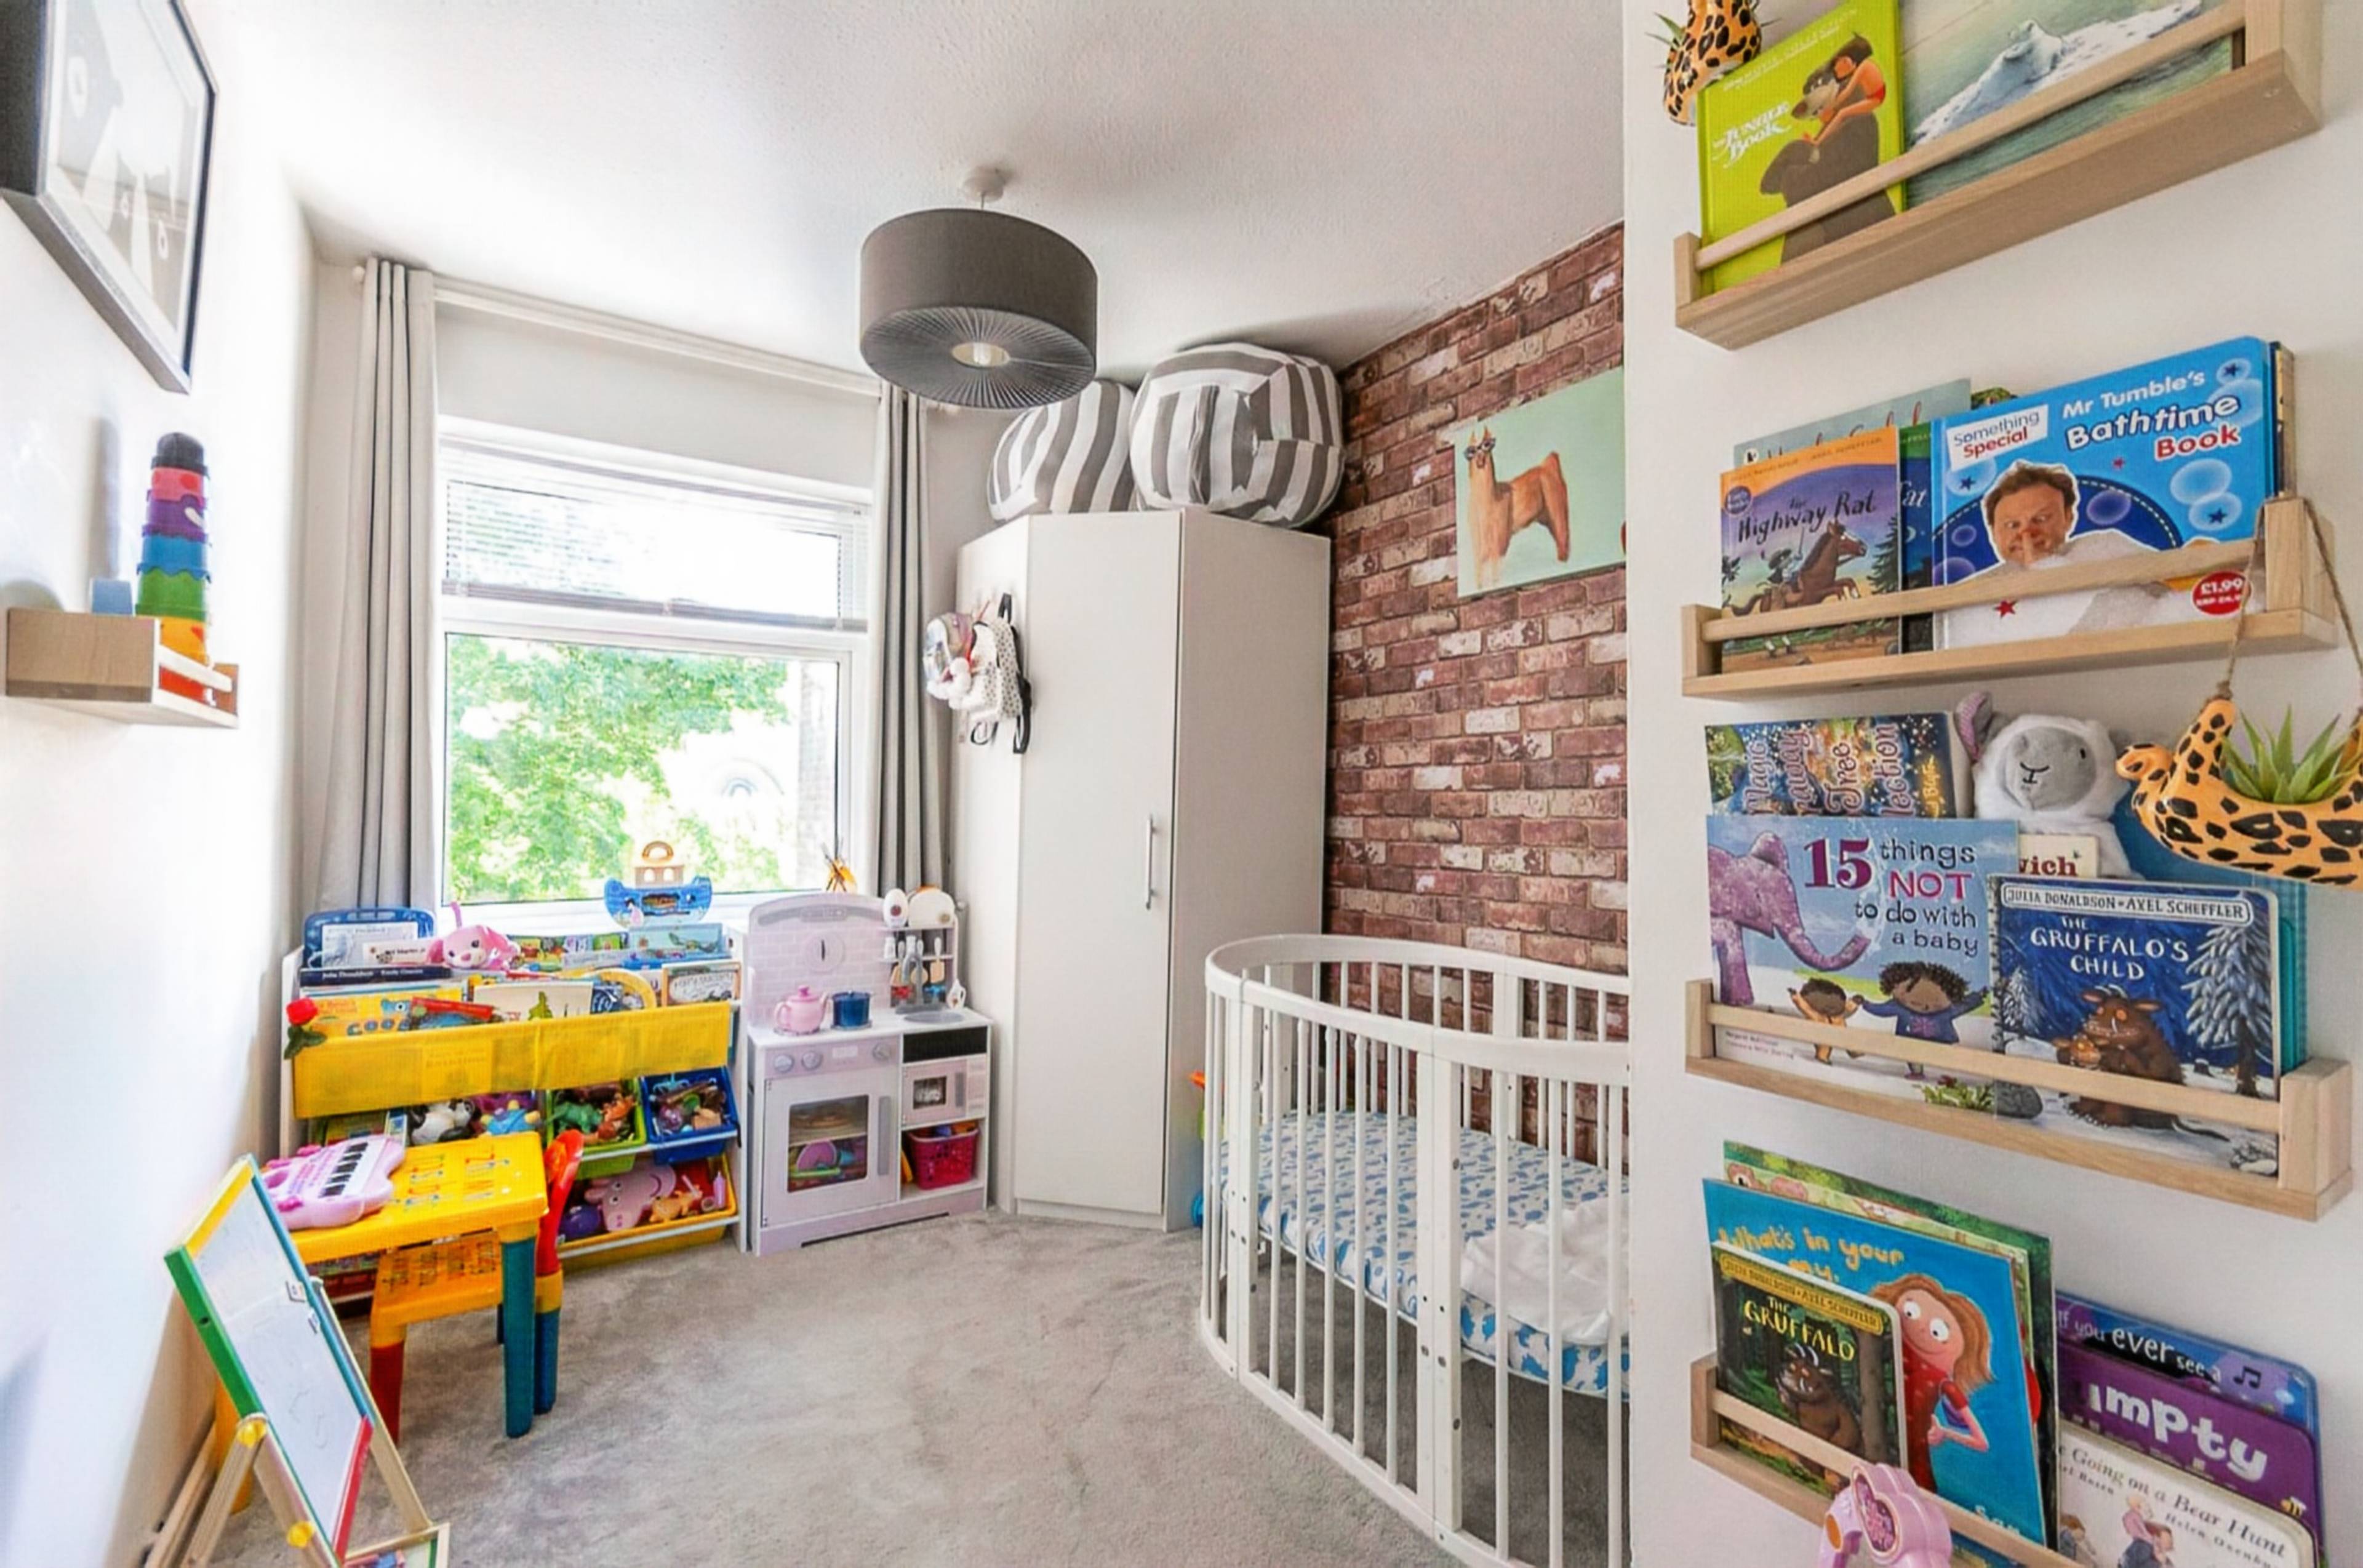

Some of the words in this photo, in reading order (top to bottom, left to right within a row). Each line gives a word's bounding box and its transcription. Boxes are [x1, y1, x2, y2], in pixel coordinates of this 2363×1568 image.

[2063, 399, 2093, 419] Mr
[2100, 370, 2205, 409] Tumble's
[1954, 411, 2040, 447] Something
[2066, 396, 2240, 450] Bathtime
[1964, 426, 2028, 458] Special
[2156, 422, 2241, 462] Book
[1738, 505, 1826, 545] Highway
[1834, 490, 1876, 518] Rat
[1823, 742, 1865, 812] Tree
[1804, 838, 1872, 890] 15
[1881, 838, 1975, 870] things
[1889, 871, 1973, 900] NOT
[1854, 901, 1878, 919] to
[1886, 900, 1916, 923] do
[1923, 905, 1977, 928] with
[2007, 889, 2041, 903] JULIA
[2045, 892, 2116, 909] DONALDSON
[2126, 897, 2163, 913] AXEL
[2167, 900, 2244, 919] SCHEFFLER
[2062, 916, 2089, 930] THE
[1892, 931, 1905, 946] a
[1914, 928, 1978, 958] baby
[2030, 927, 2189, 962] GRUFFALO'S
[2070, 955, 2145, 980] CHILD
[1839, 1237, 1905, 1271] your
[1768, 1295, 1788, 1312] THE
[1744, 1300, 1855, 1361] GRUFFALO
[2074, 1321, 2105, 1343] you
[2112, 1327, 2175, 1363] ever
[2177, 1355, 2205, 1377] see
[2073, 1447, 2124, 1487] Going
[2129, 1478, 2150, 1495] on
[2155, 1490, 2167, 1502] a
[2175, 1494, 2221, 1526] Bear
[2228, 1519, 2285, 1559] Hunt
